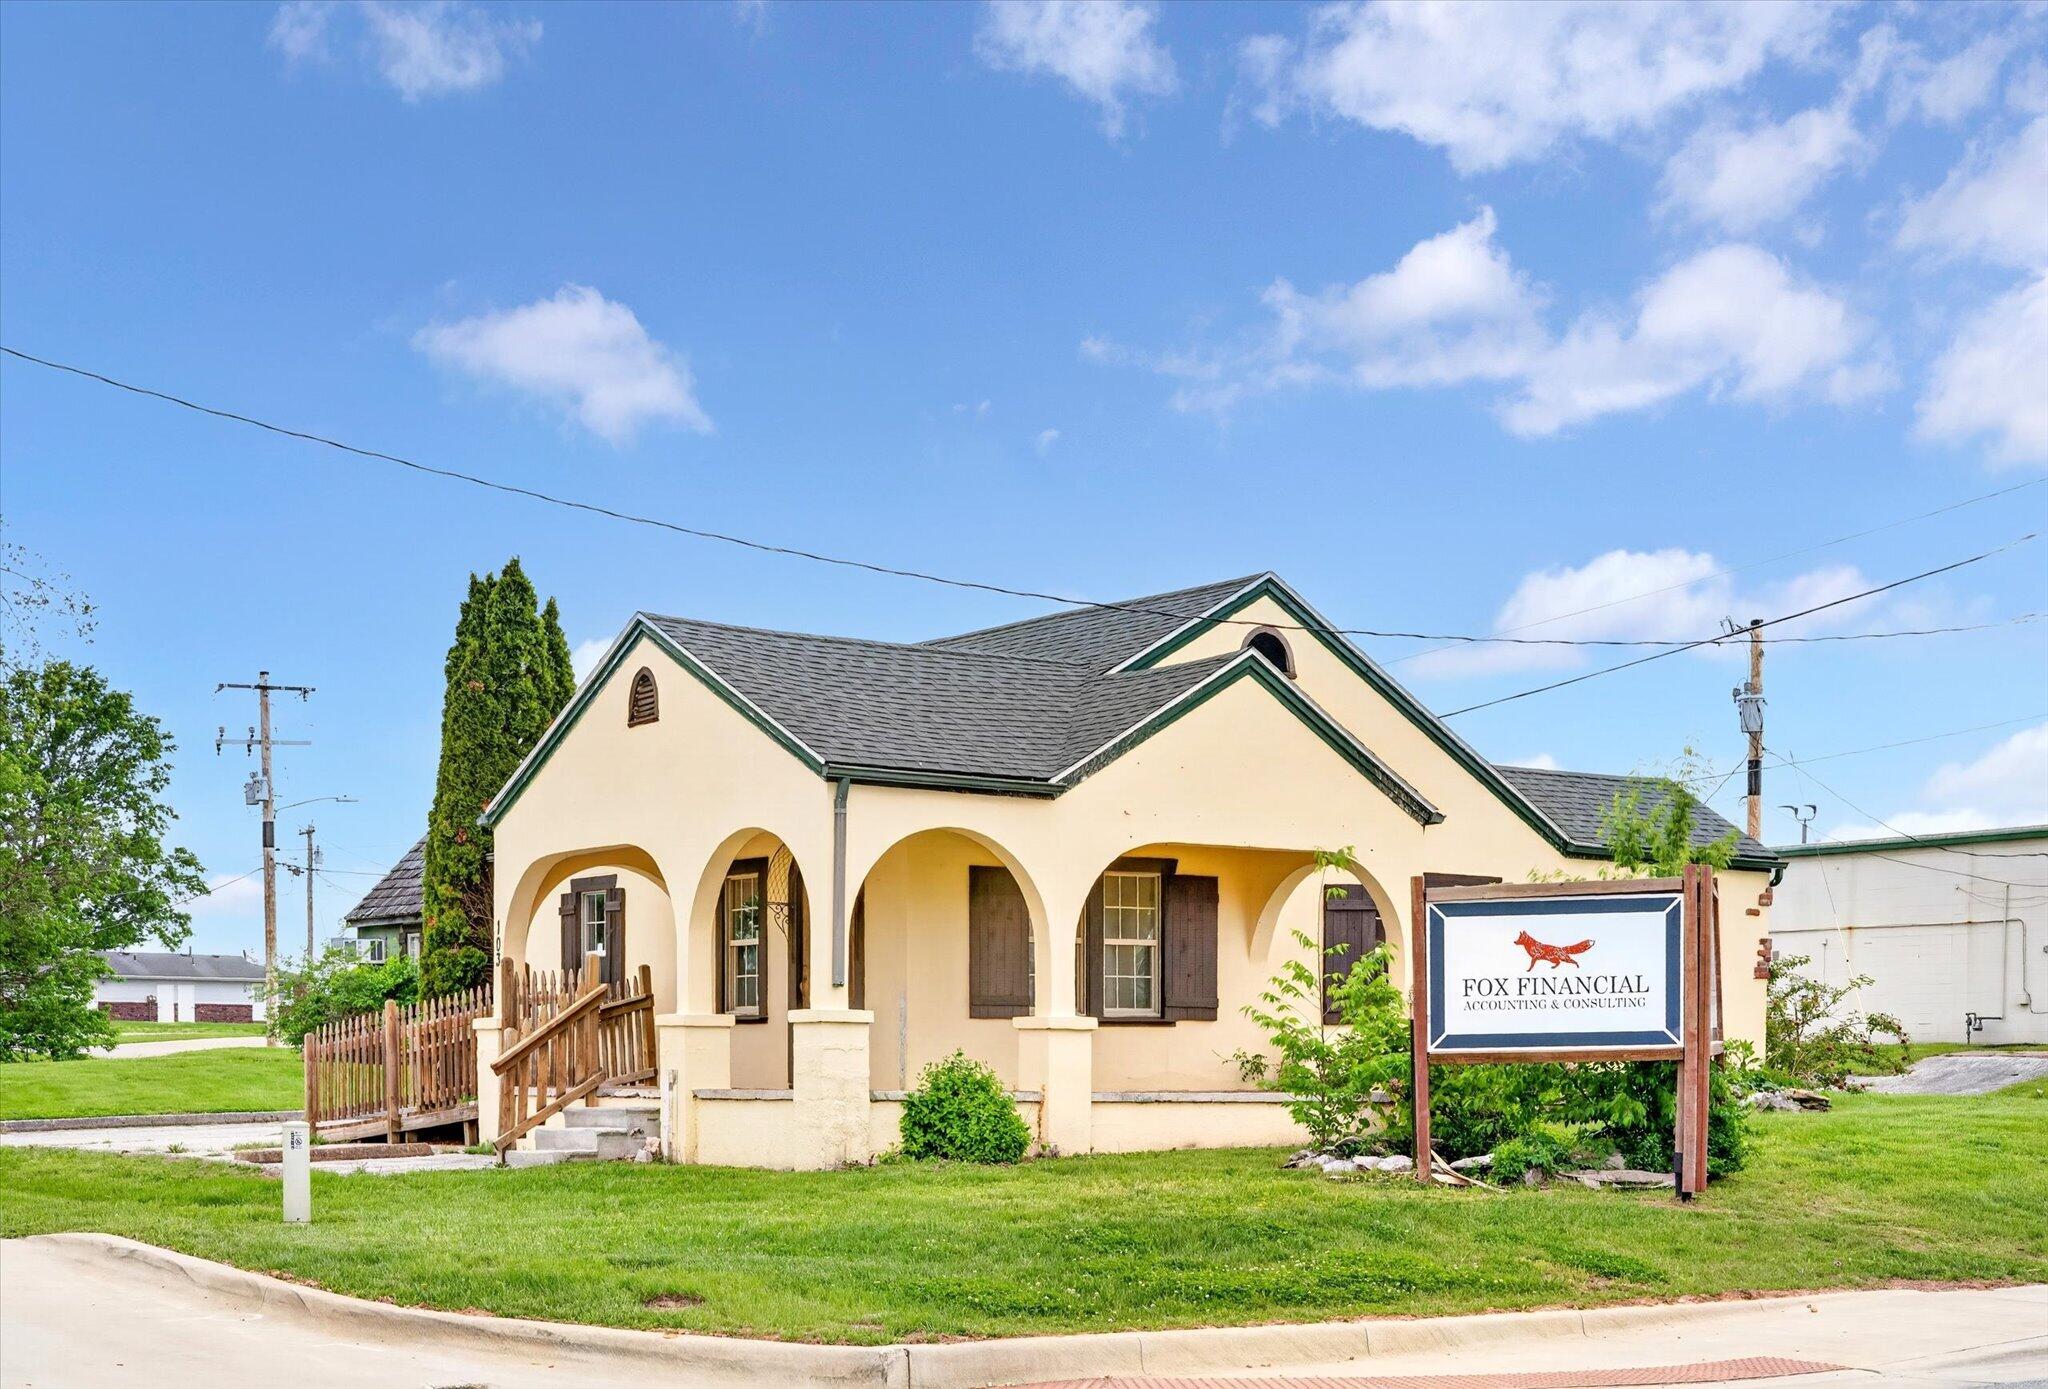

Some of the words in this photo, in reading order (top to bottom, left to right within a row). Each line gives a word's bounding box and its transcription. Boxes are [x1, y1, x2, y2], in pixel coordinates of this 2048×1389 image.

[1462, 978, 1509, 997] FOX
[1517, 975, 1650, 996] FINANCIAL
[1463, 999, 1547, 1011] ACCOUNTING
[1550, 999, 1560, 1009] &
[1563, 997, 1646, 1009] CONSULTING
